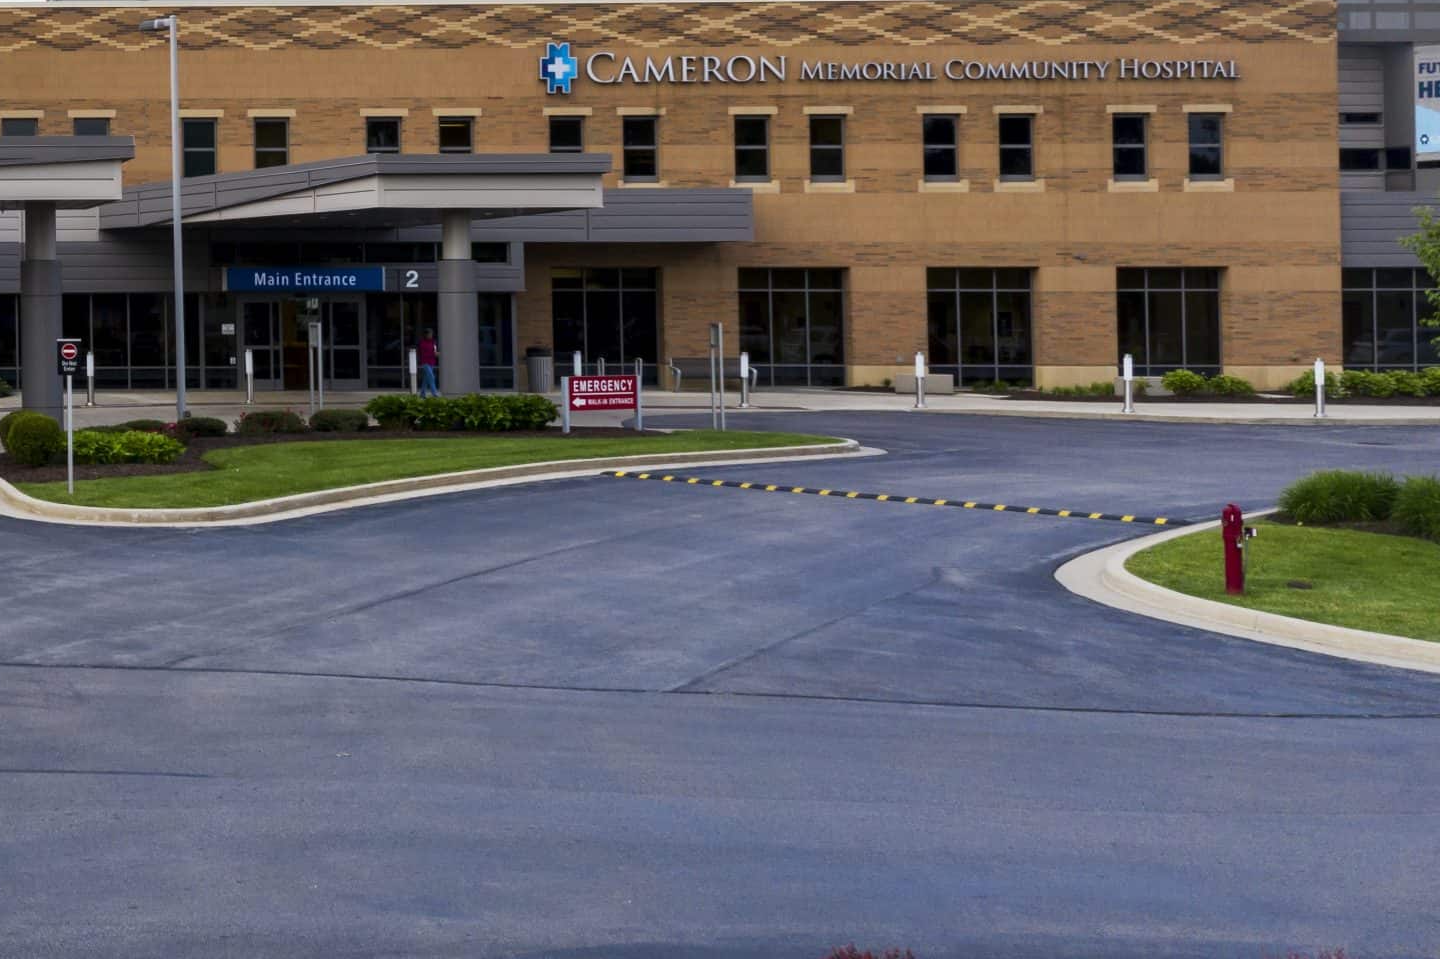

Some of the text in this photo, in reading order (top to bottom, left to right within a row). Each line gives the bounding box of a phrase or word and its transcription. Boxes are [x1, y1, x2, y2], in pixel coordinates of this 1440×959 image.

[586, 52, 1241, 83] CAMERON MEMORIAL COMMUNITY HOSPITAL
[254, 272, 357, 286] Main Entrance
[406, 270, 419, 288] 2
[573, 380, 633, 392] EMERGENCY
